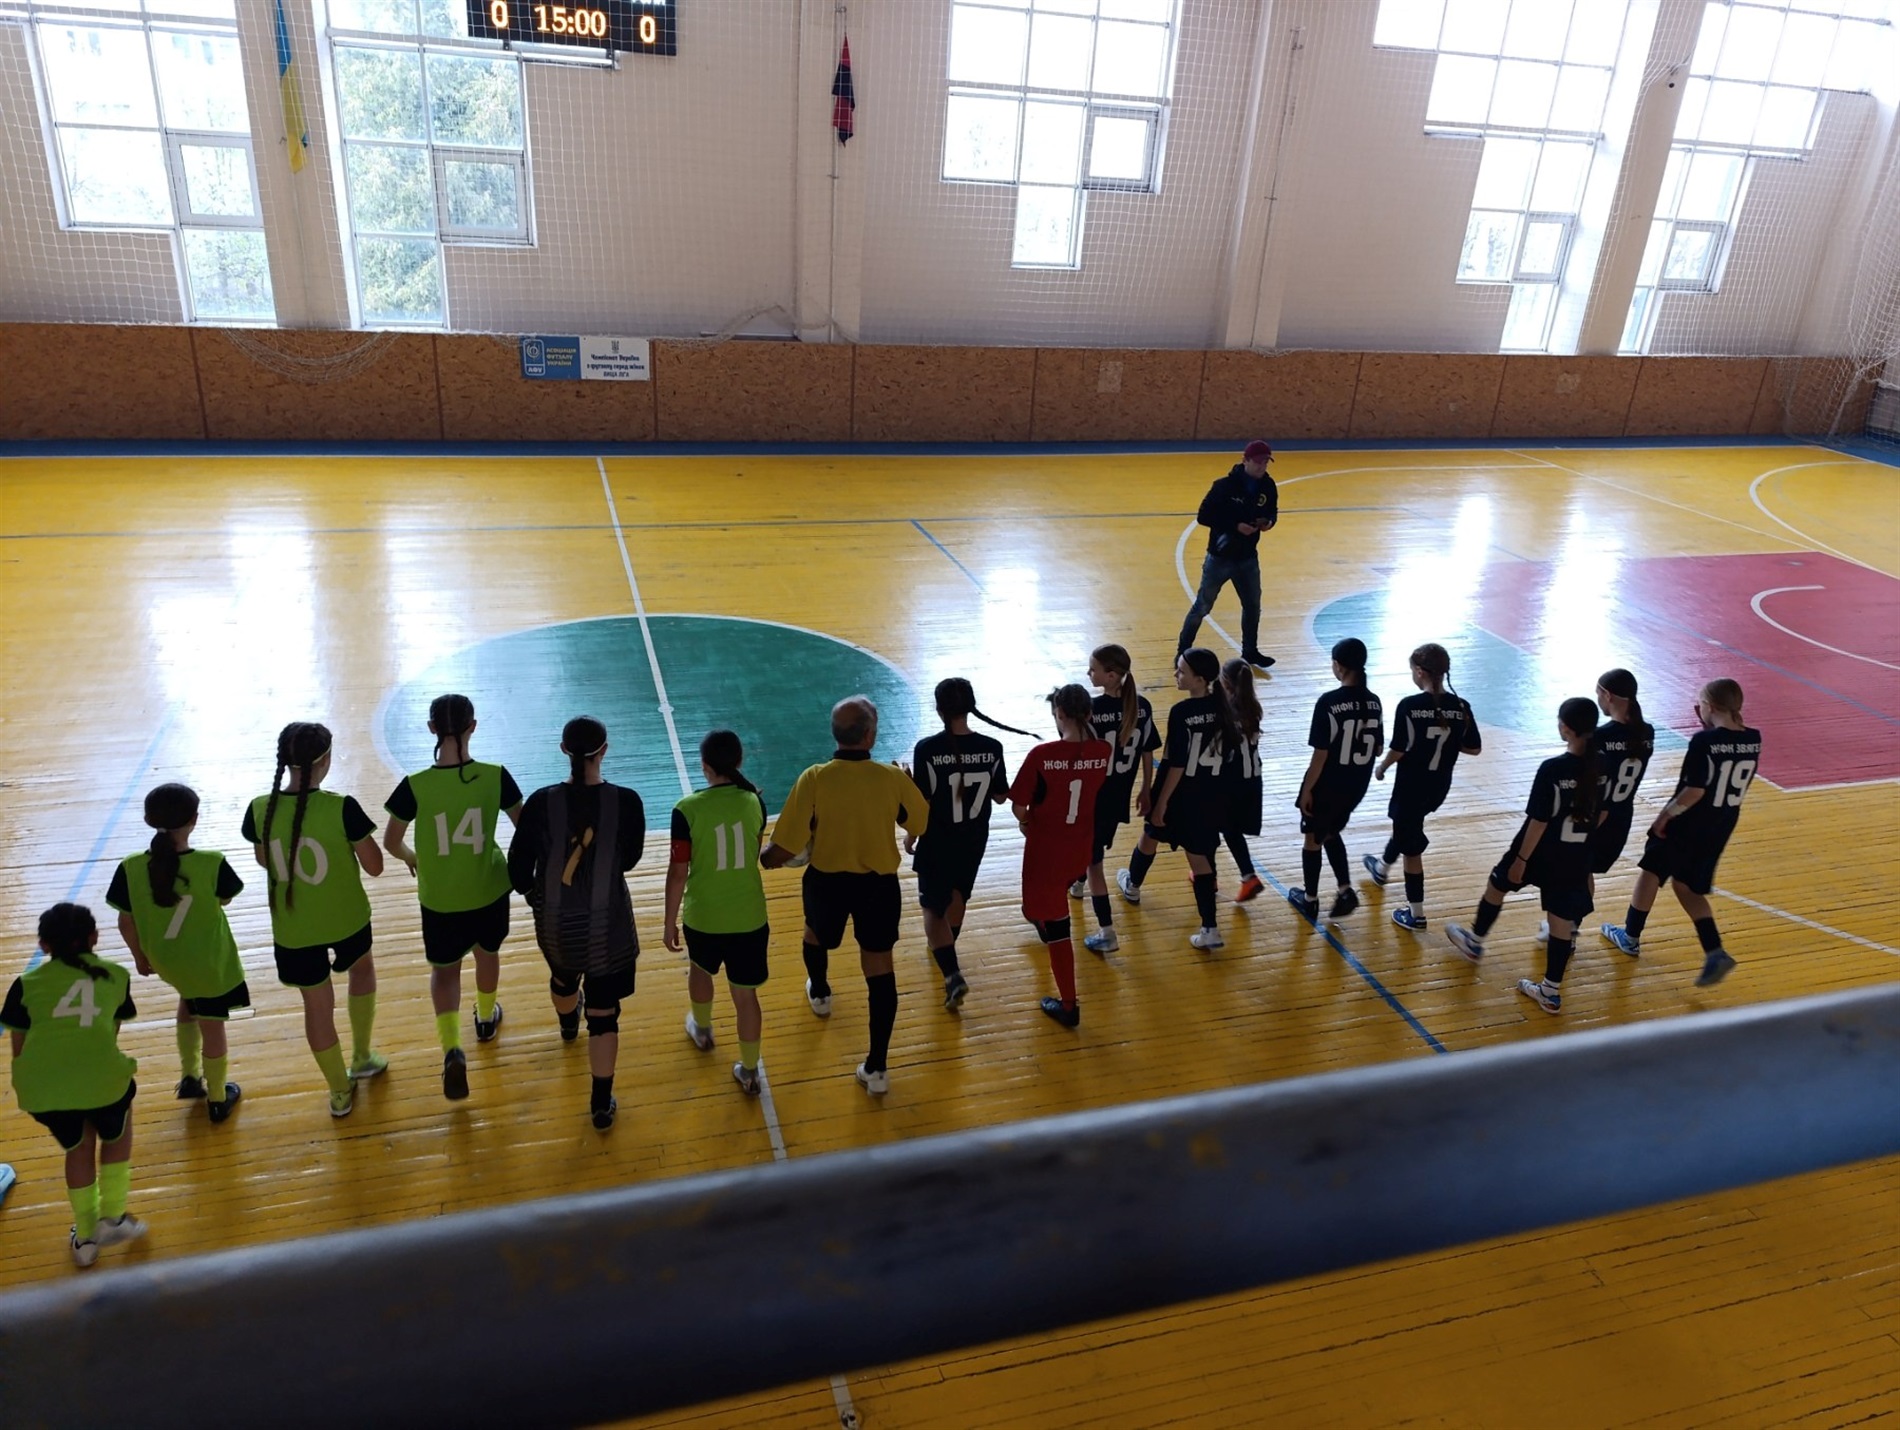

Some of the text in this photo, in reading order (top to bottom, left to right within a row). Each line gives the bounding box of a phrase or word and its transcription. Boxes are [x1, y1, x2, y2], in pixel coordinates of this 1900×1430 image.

[491, 0, 508, 28] 0
[534, 5, 607, 37] 15:00
[640, 15, 656, 43] 0
[1092, 712, 1116, 724] ЖФК
[1185, 715, 1205, 726] ЖФК
[1330, 701, 1354, 715] ЖФК
[1410, 709, 1435, 719] ЖФК
[932, 754, 957, 766] ЖФК
[1105, 728, 1142, 777] 13
[1185, 729, 1223, 777] 14
[1339, 718, 1379, 766] 15
[1426, 726, 1452, 771] 7
[1709, 743, 1734, 754] ЖФК
[1043, 759, 1069, 771] ЖФК
[1612, 757, 1643, 803] 8
[1712, 760, 1756, 807] 19
[948, 771, 991, 824] 17
[1066, 779, 1082, 824] 1
[434, 807, 486, 857] 14
[714, 821, 746, 872] 11
[270, 837, 328, 886] 10
[52, 978, 101, 1028] 4
